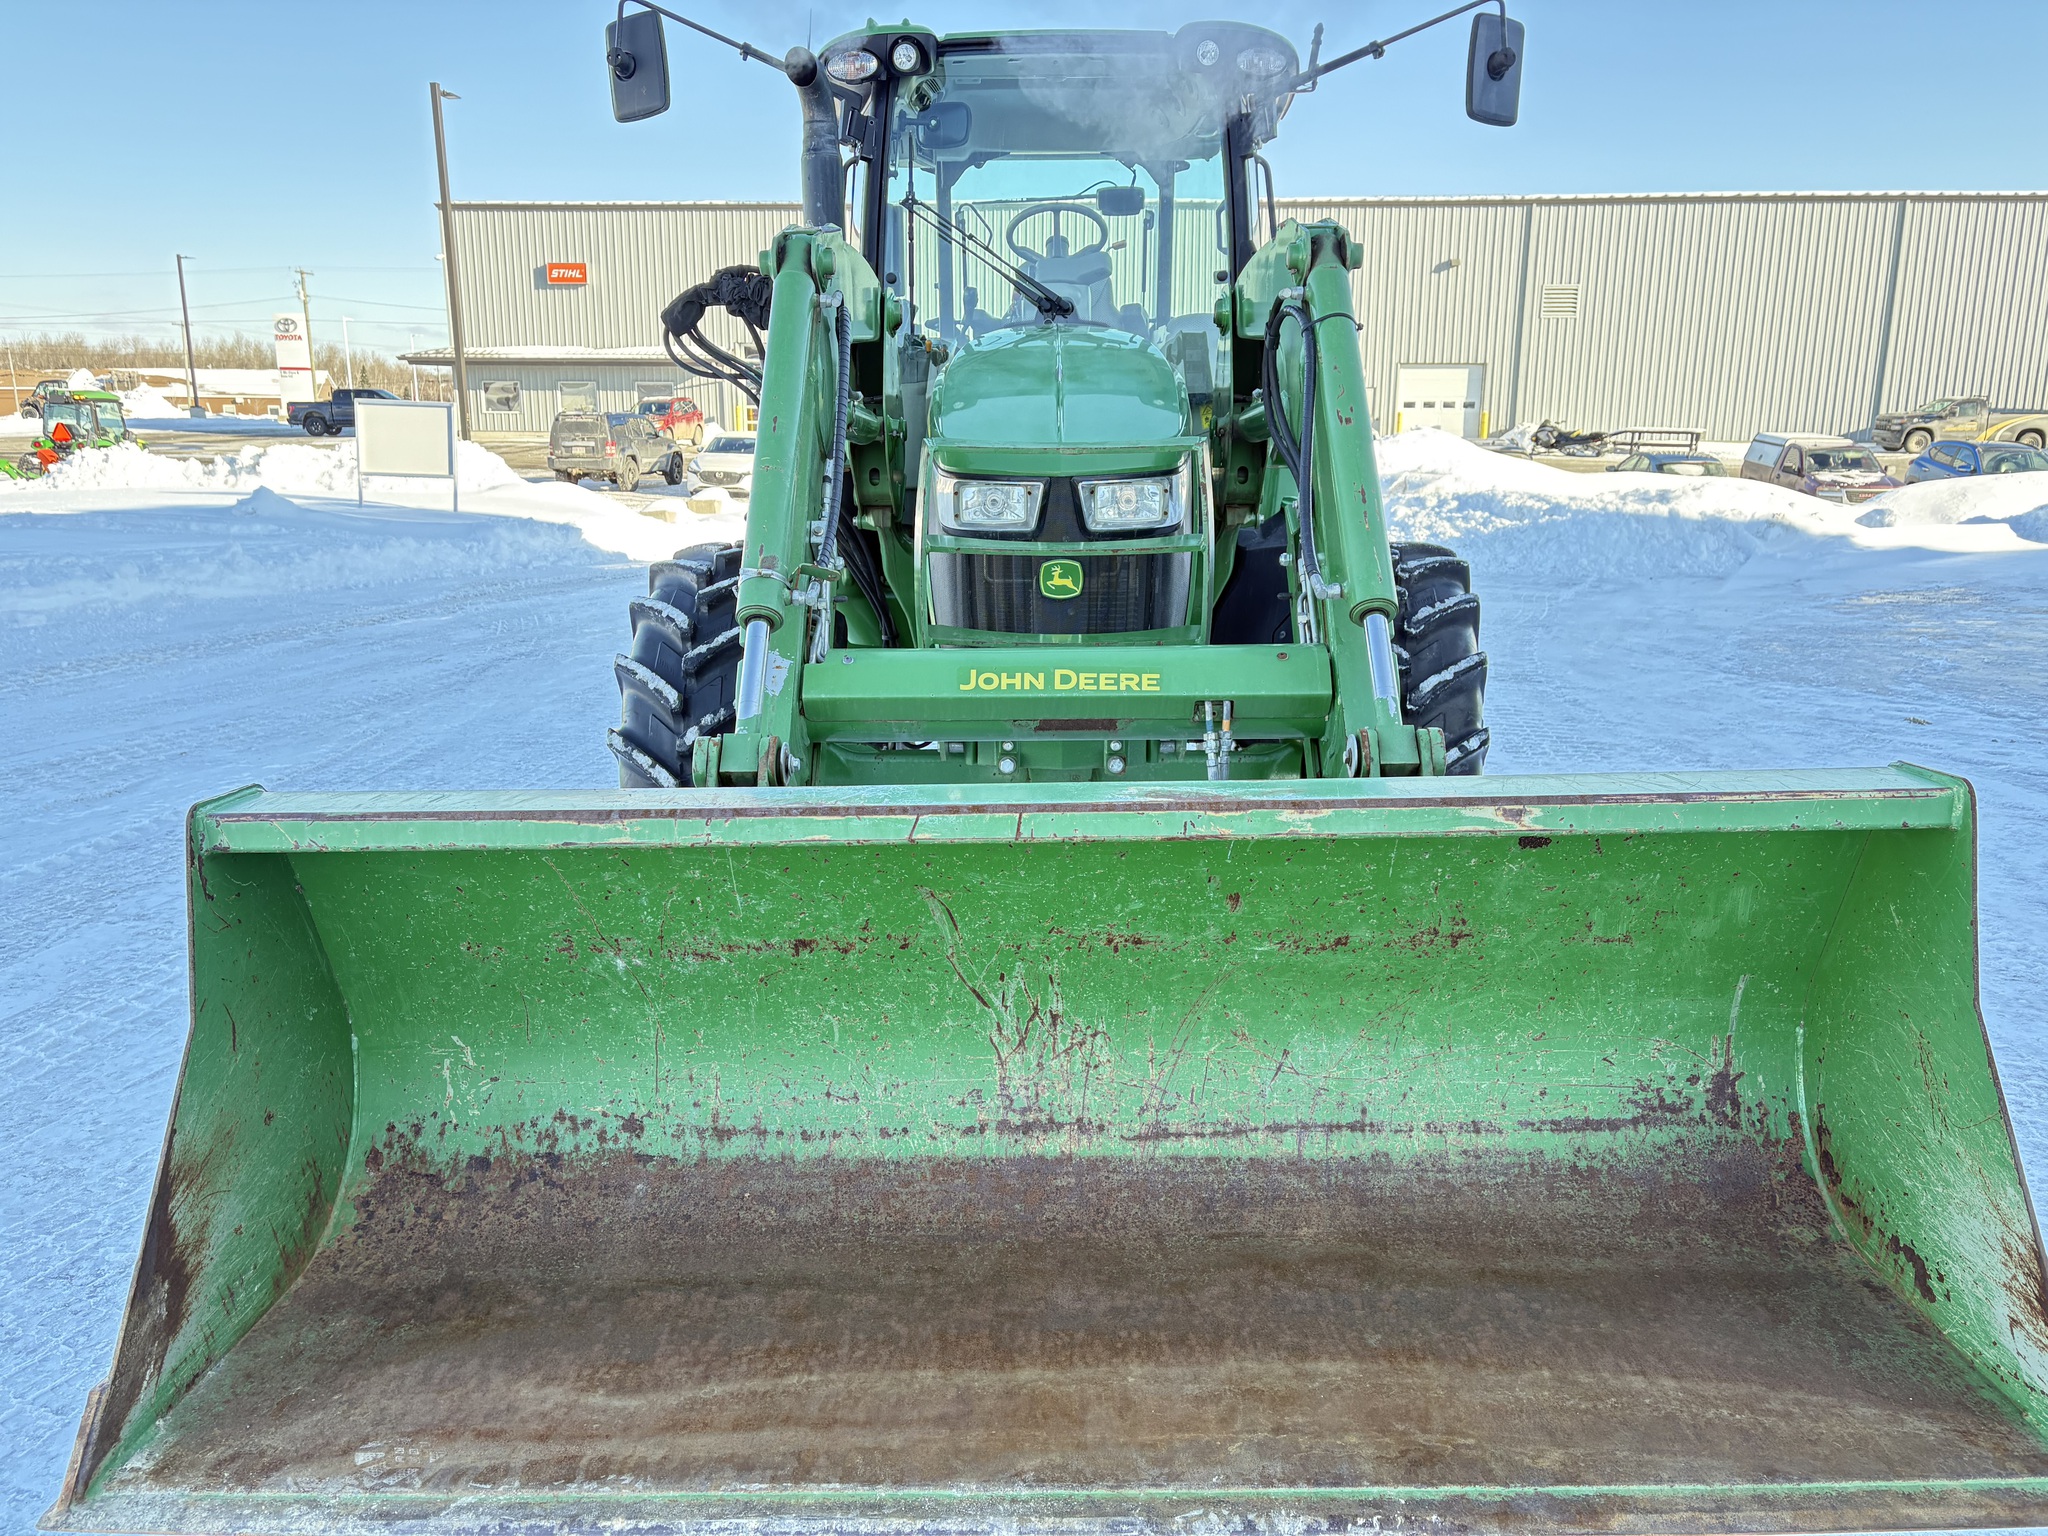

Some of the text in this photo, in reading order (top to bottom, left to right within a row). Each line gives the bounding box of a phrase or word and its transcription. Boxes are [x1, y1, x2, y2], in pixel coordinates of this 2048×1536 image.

[550, 269, 583, 278] STIHL
[959, 669, 1161, 691] JOHN DEERE
